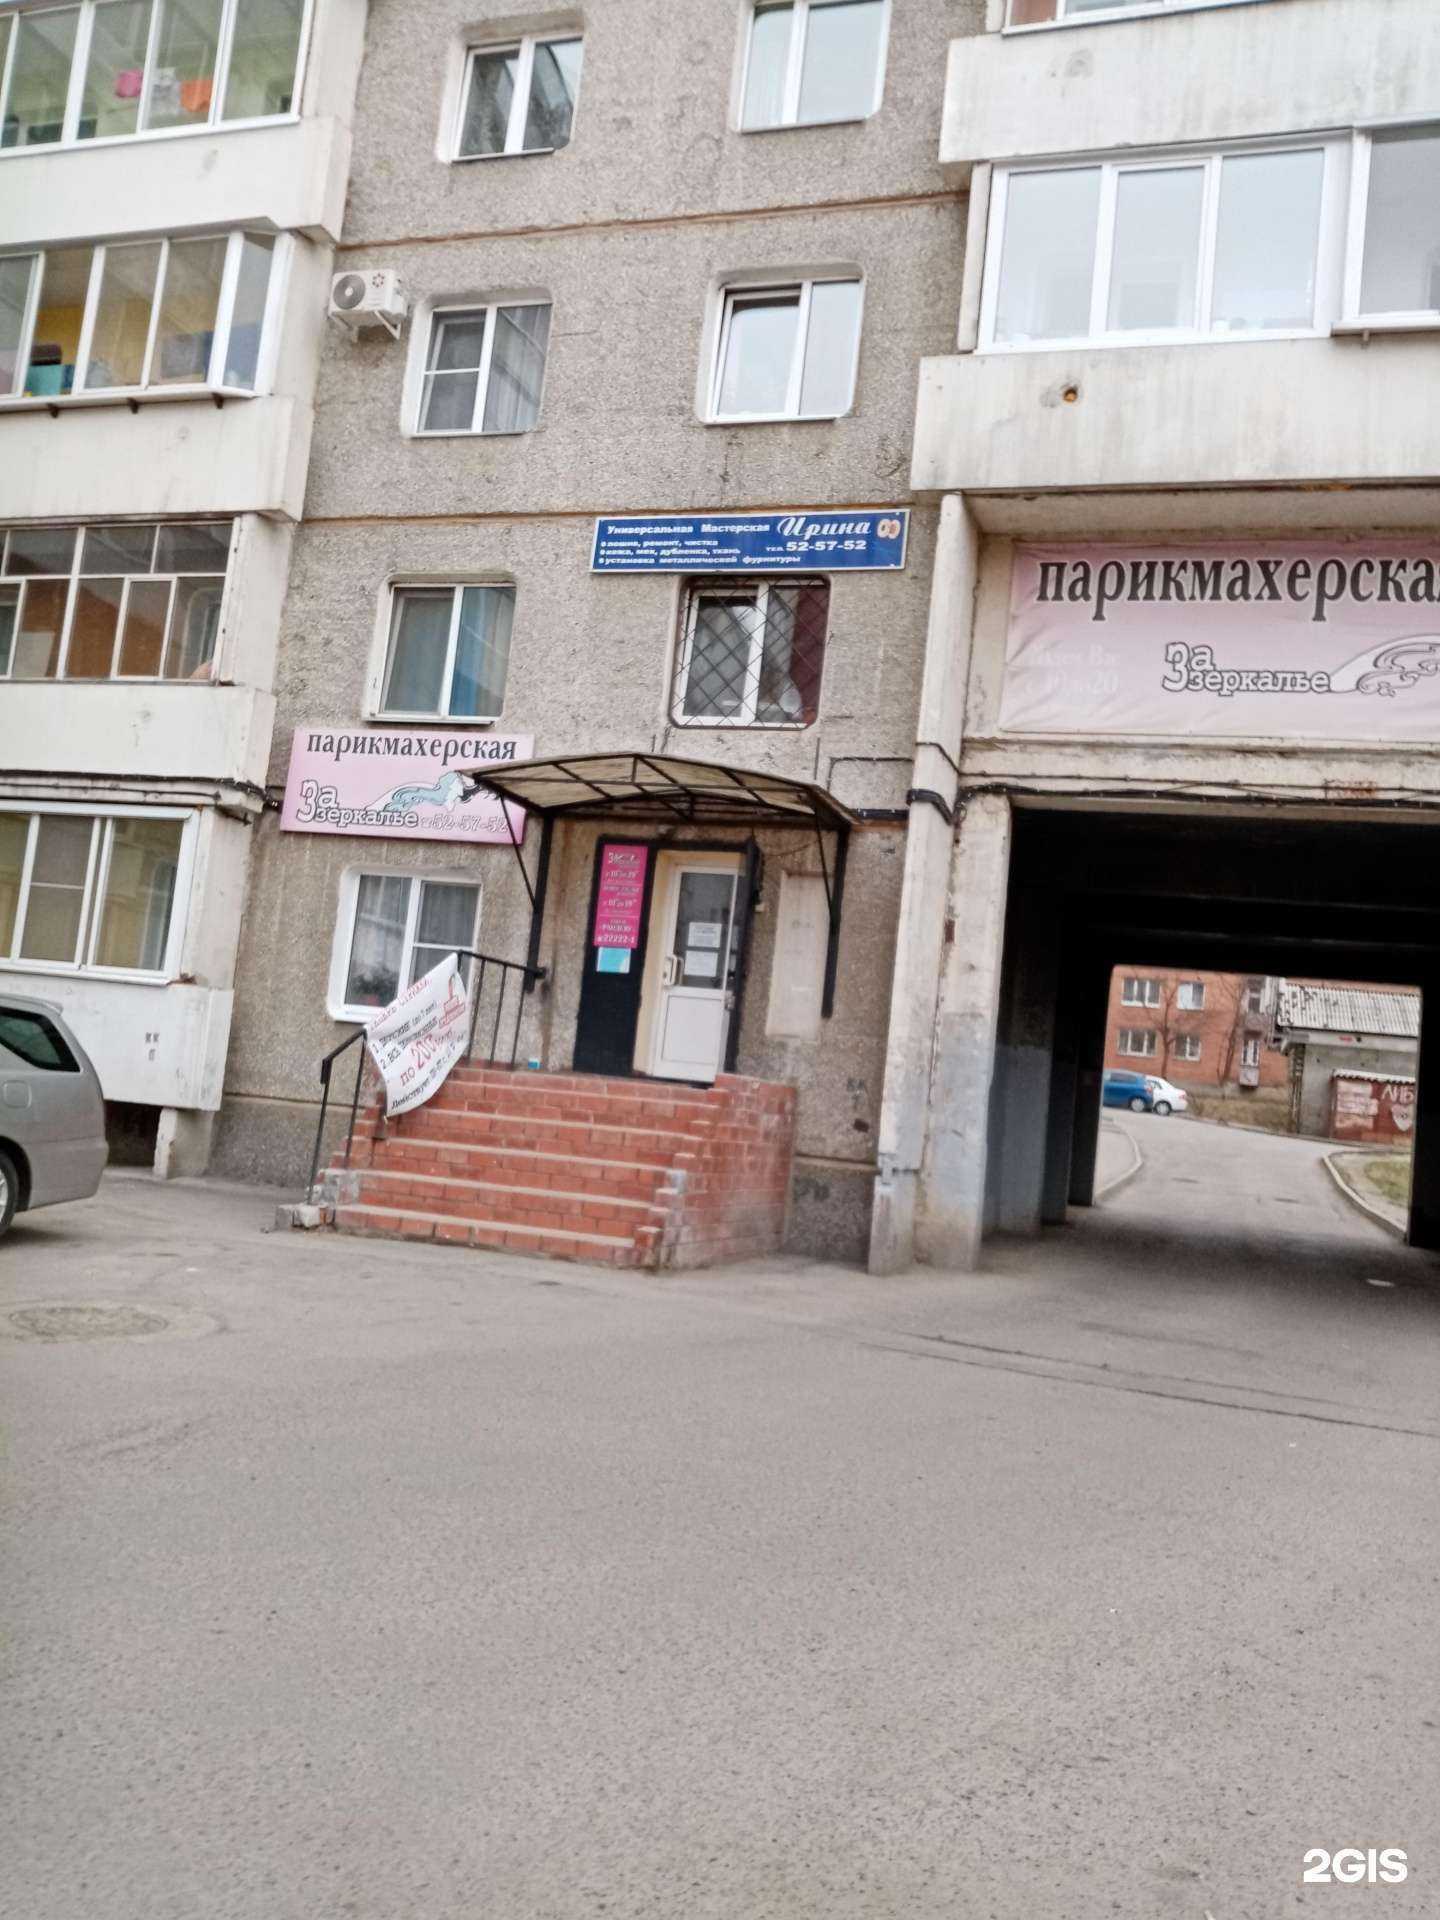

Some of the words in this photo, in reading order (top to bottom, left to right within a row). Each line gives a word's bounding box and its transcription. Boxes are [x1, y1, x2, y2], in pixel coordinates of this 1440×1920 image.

[607, 525, 693, 535] Универсальная
[701, 523, 770, 534] Мастерская
[777, 517, 871, 541] Ирина
[786, 540, 867, 552] 52-57-52
[307, 732, 518, 766] парикмахерская
